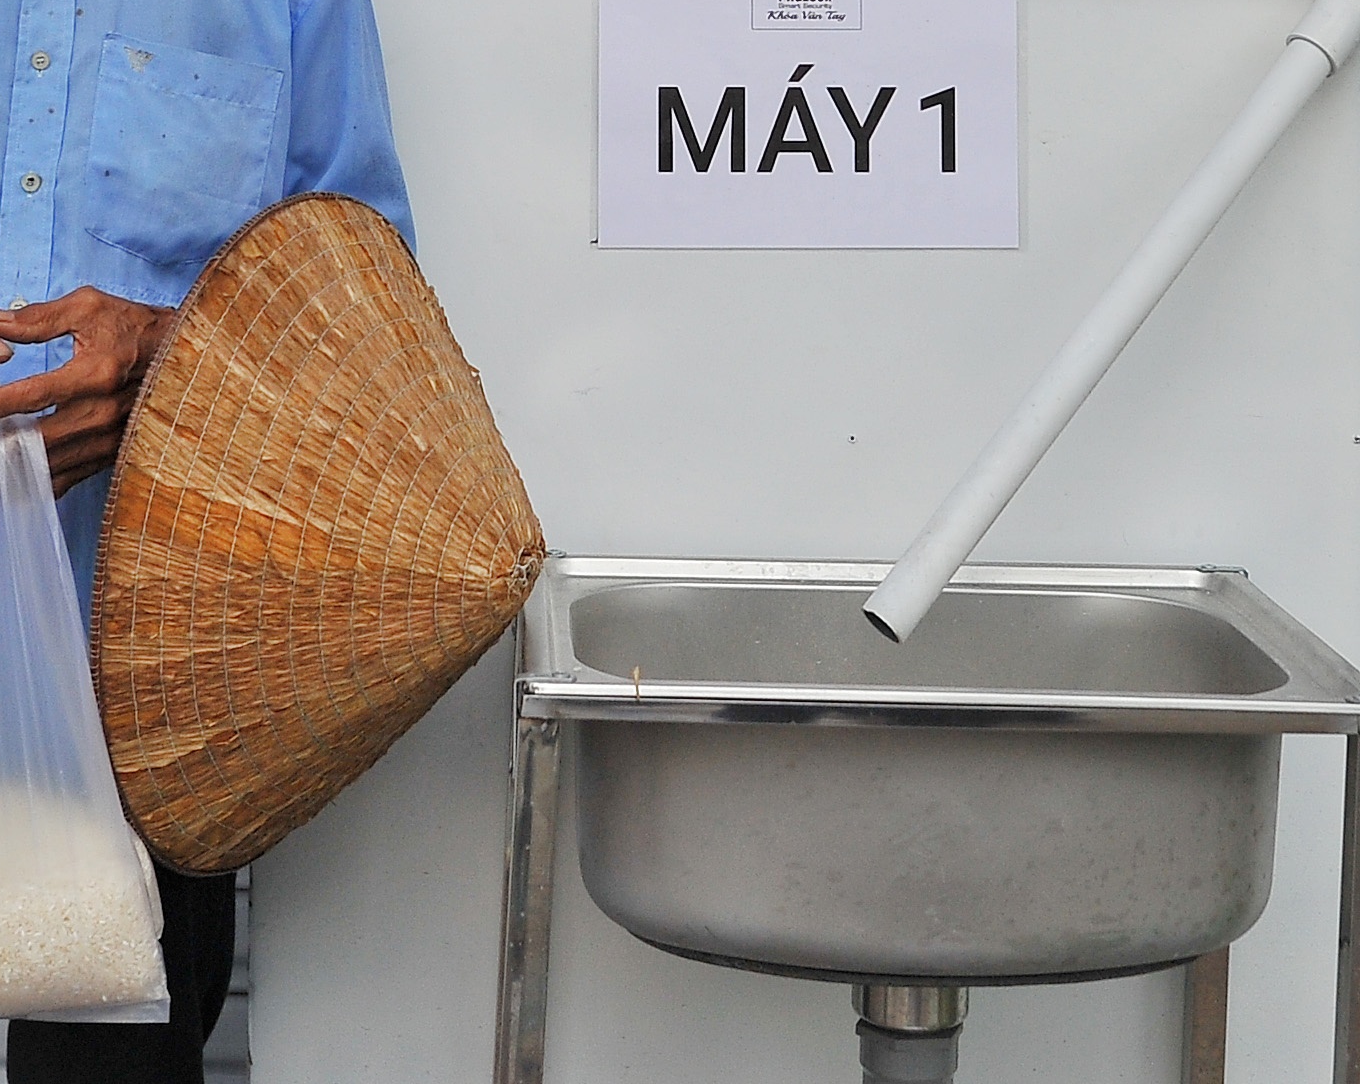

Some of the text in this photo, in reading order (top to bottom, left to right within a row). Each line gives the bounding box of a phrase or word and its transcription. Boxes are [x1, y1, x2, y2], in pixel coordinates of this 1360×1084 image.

[825, 10, 846, 21] Tay
[657, 63, 957, 174] MÁY 1
